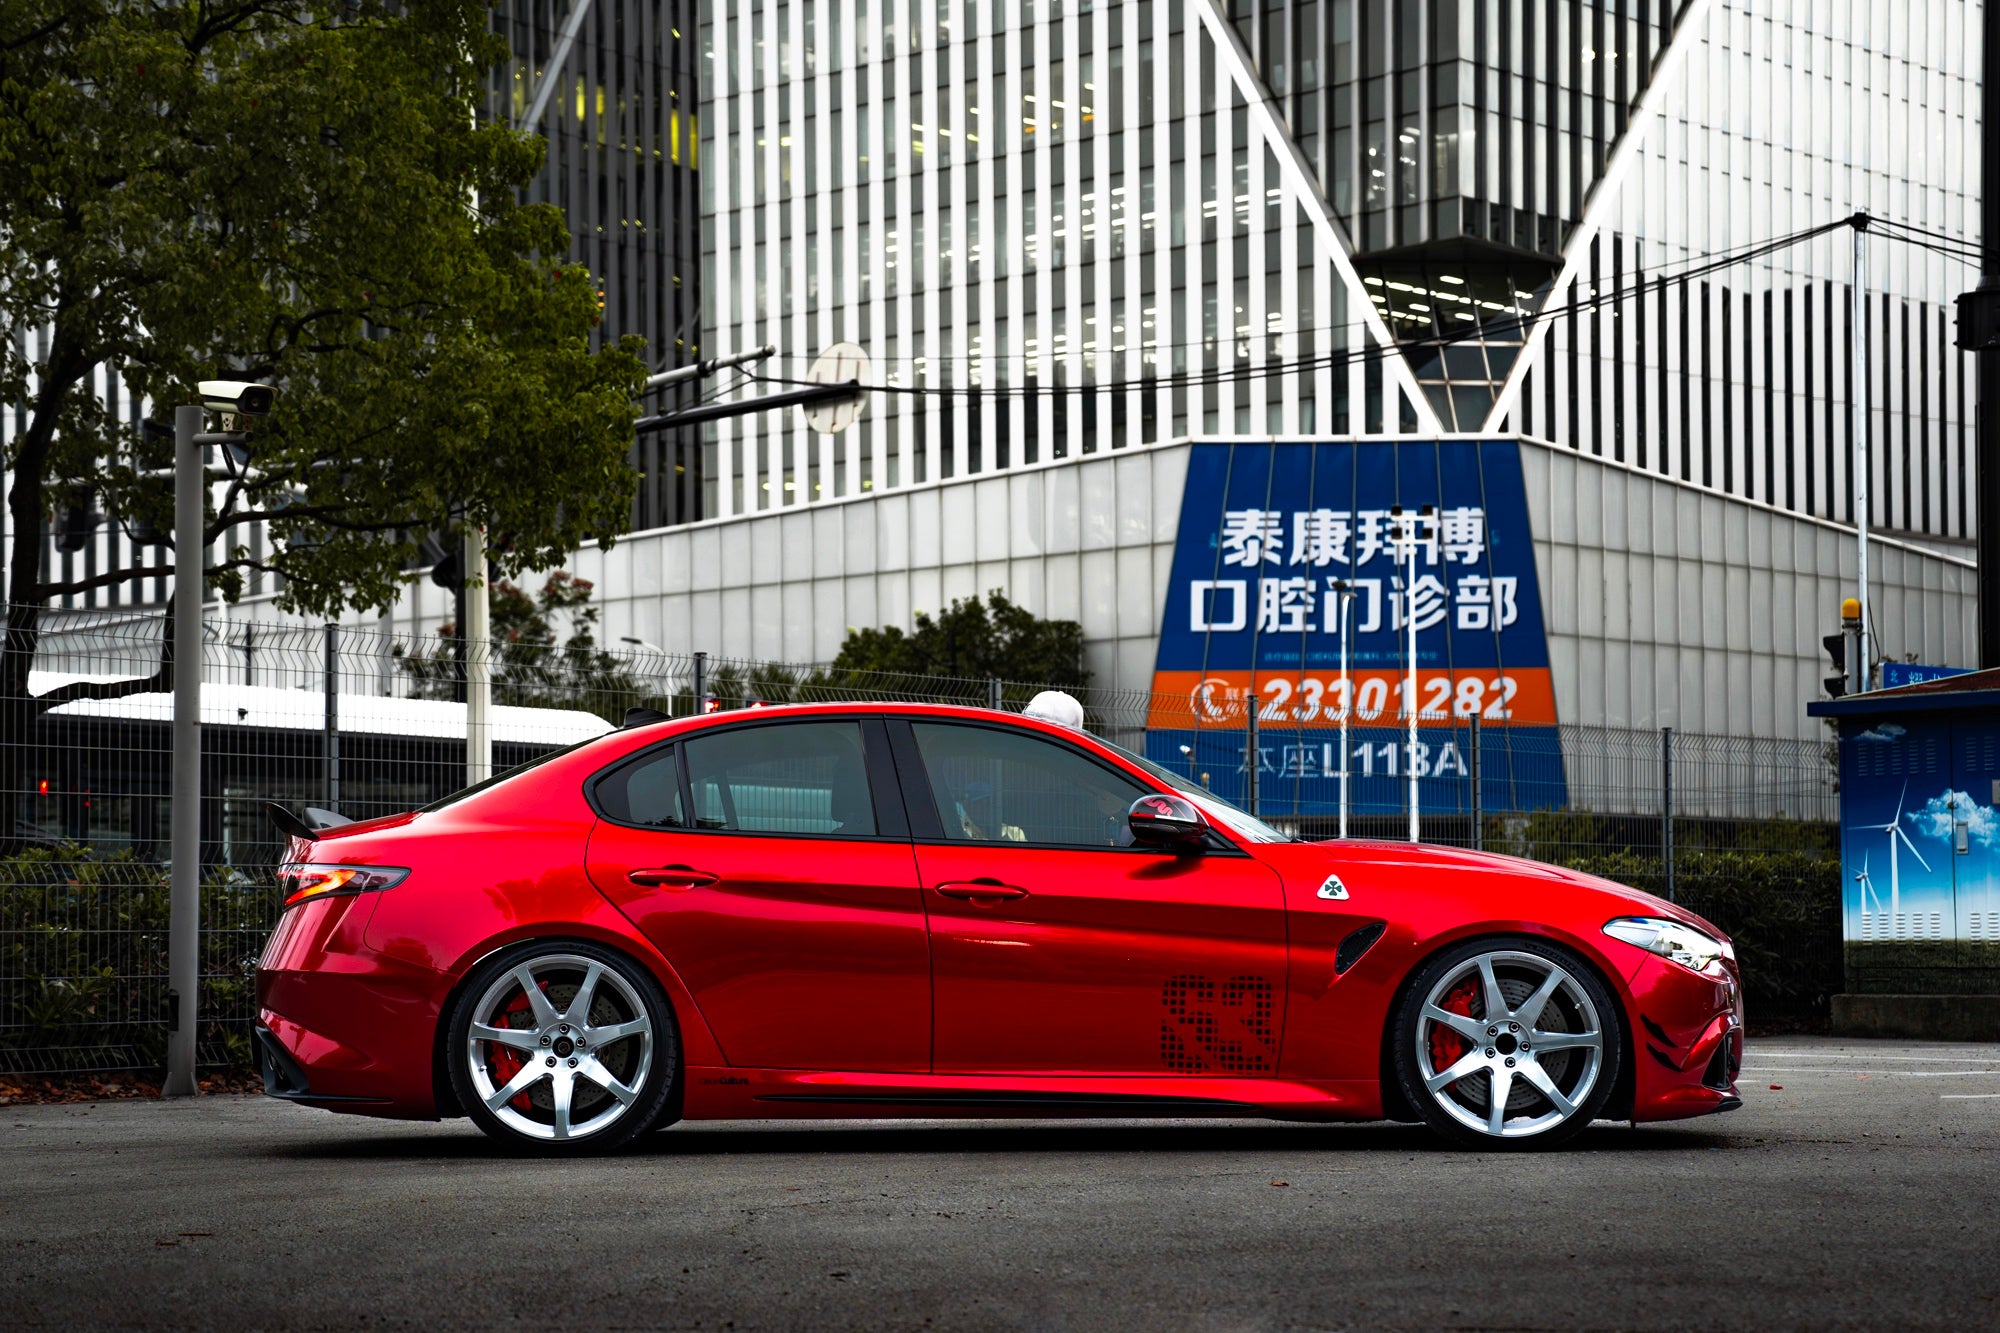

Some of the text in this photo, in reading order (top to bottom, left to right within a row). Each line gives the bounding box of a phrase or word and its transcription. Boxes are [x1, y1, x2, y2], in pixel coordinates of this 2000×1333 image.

[1222, 507, 1485, 567] 泰康拜博
[1190, 574, 1518, 633] 口腔门诊部
[1259, 677, 1518, 721] 23301282
